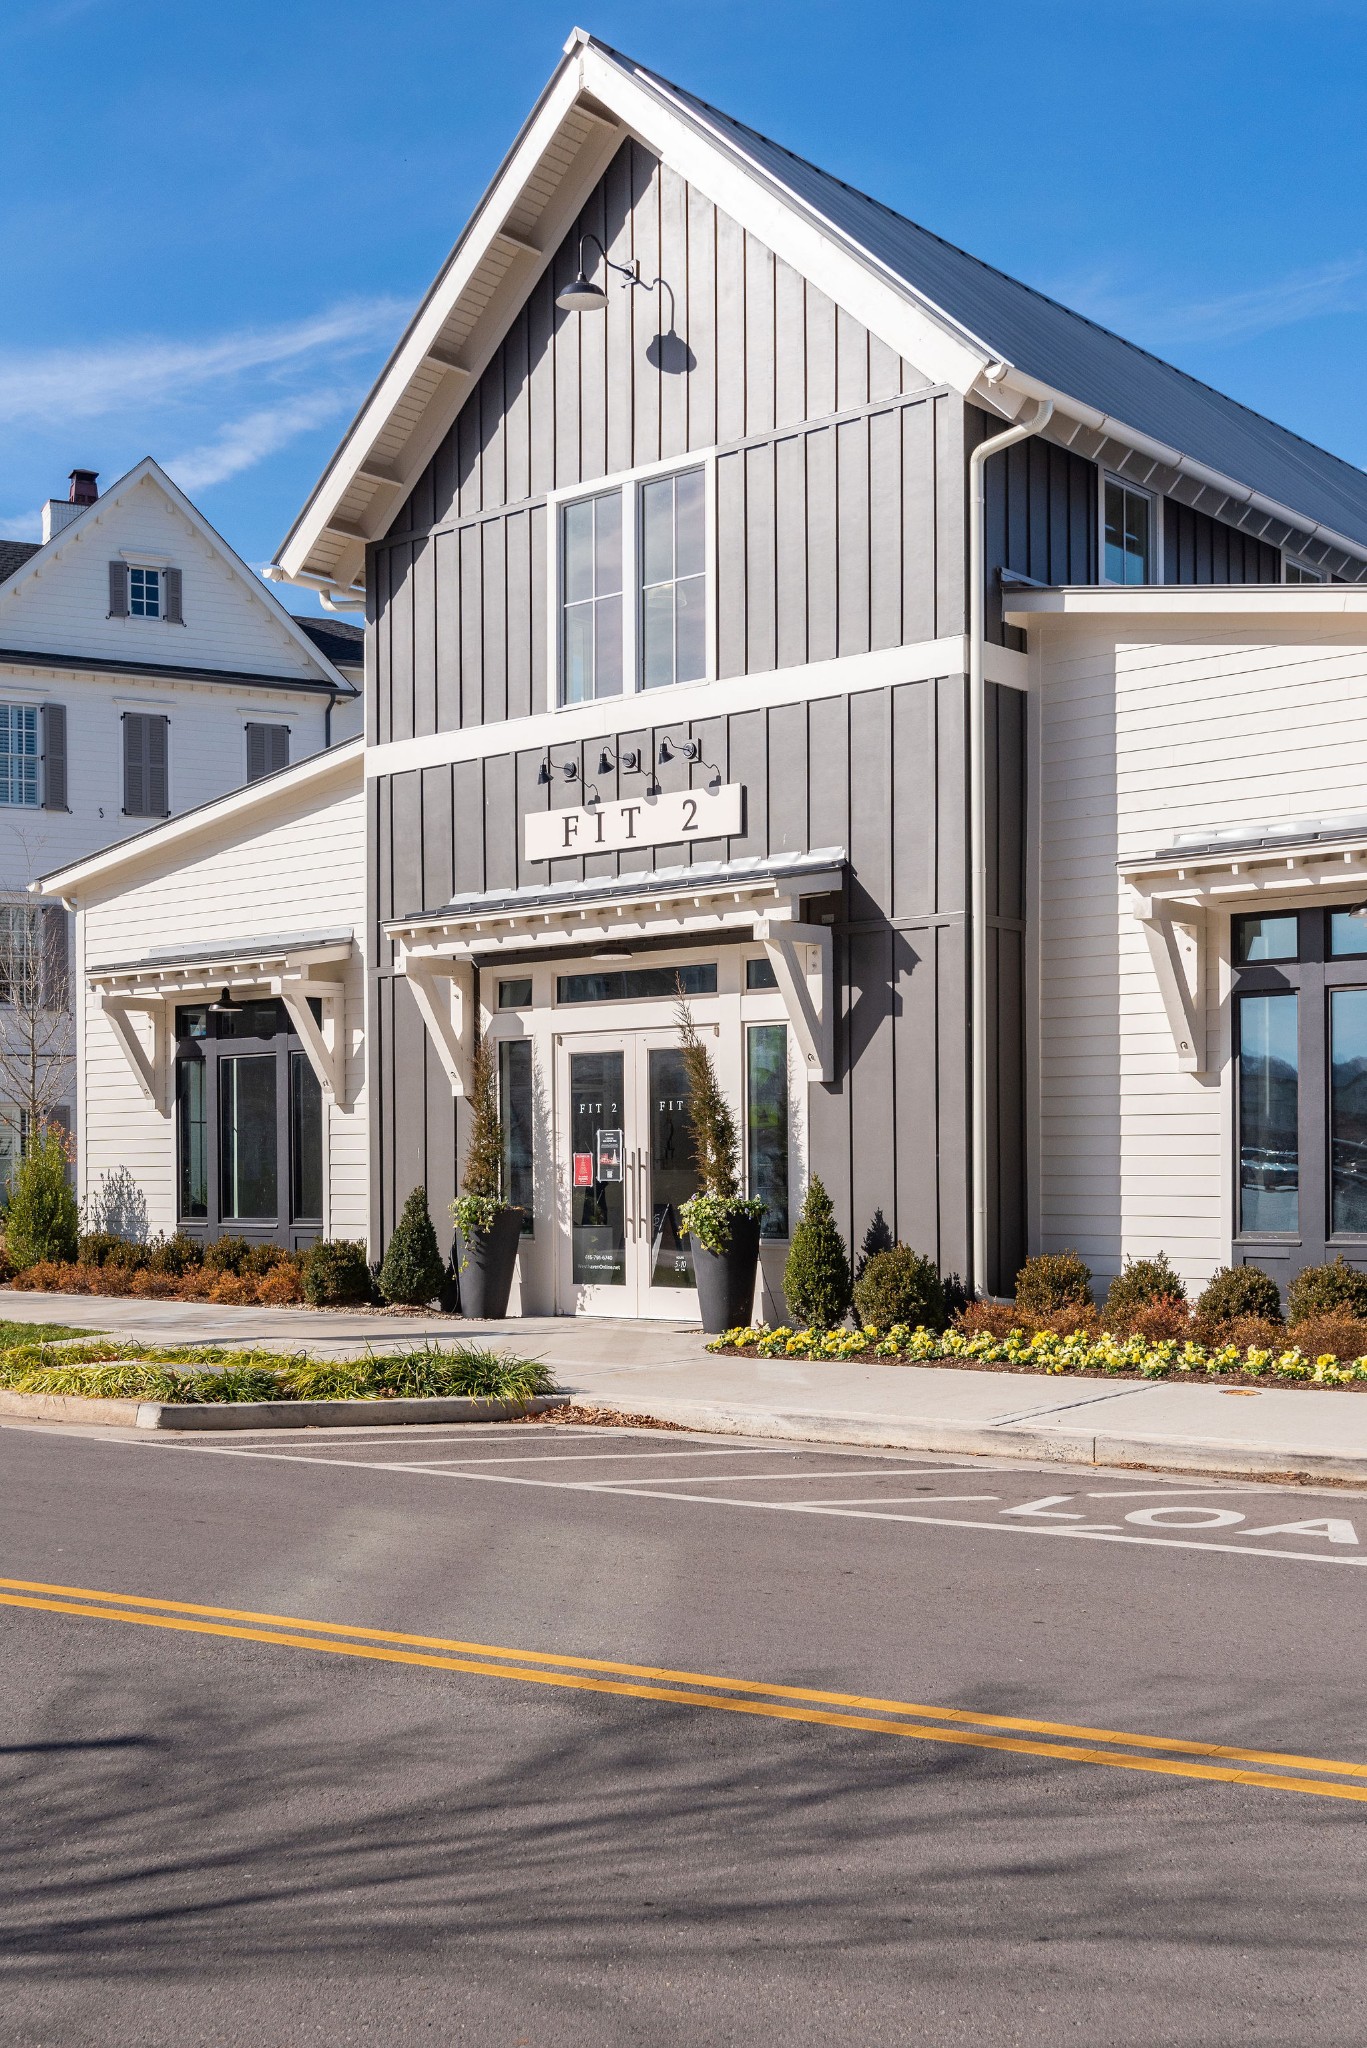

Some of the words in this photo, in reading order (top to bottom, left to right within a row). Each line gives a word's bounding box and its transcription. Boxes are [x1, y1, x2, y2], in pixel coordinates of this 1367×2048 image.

[562, 806, 641, 847] FIT
[682, 799, 699, 831] 2
[579, 1103, 602, 1114] FIT
[611, 1103, 618, 1112] 2
[659, 1100, 683, 1111] FIT
[998, 1496, 1359, 1545] LOA
